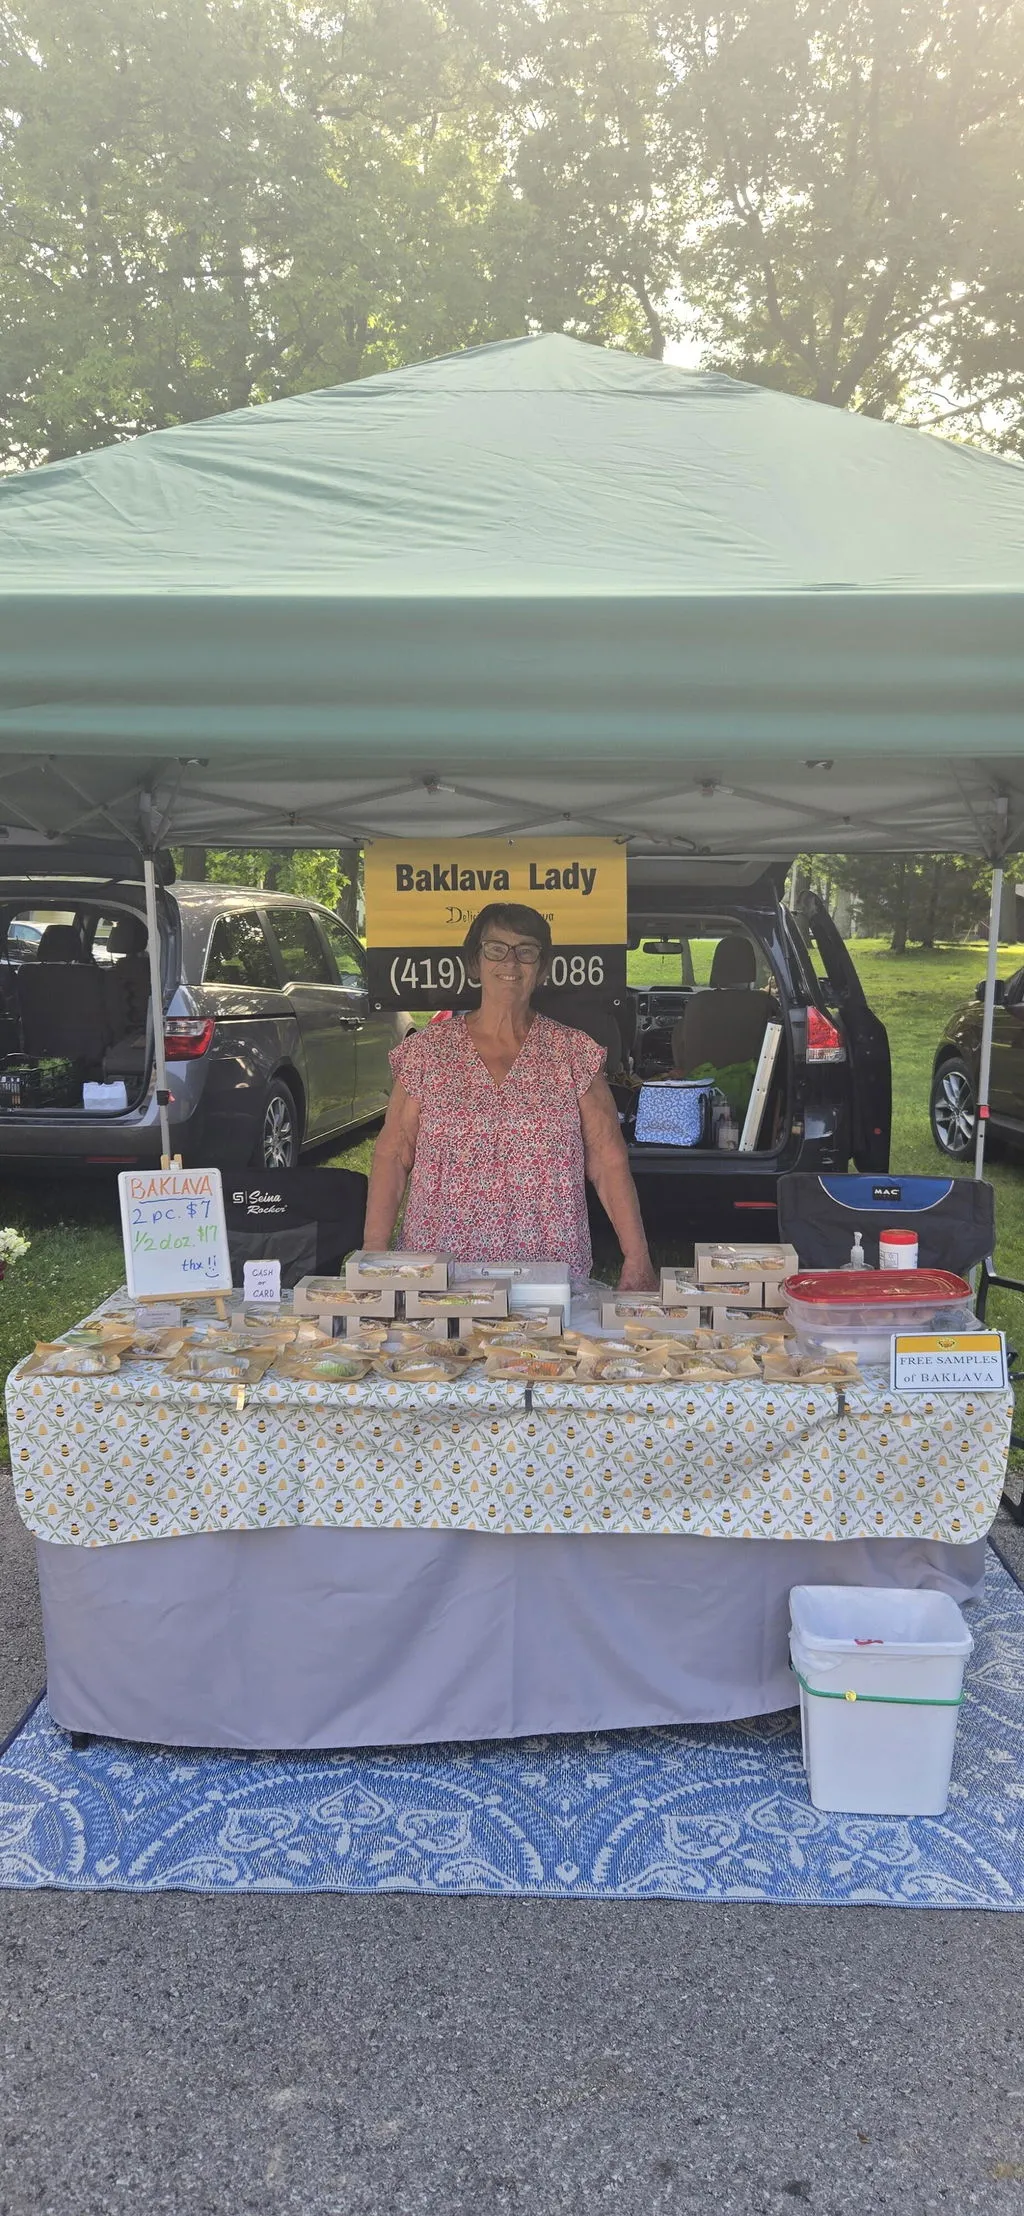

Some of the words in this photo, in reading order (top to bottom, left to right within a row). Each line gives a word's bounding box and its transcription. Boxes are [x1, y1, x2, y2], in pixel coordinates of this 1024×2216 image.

[396, 863, 510, 892] Baklava
[529, 862, 597, 895] Lady
[131, 1175, 213, 1199] BAKLAVA
[248, 1190, 282, 1204] Seina
[132, 1208, 147, 1225] 2
[152, 1209, 181, 1224] pc.
[186, 1200, 211, 1219] $7
[197, 1225, 218, 1243] $17
[182, 1259, 204, 1272] thx
[252, 1269, 274, 1277] CASH
[252, 1289, 275, 1298] CARD
[900, 1357, 933, 1365] FREE
[936, 1355, 998, 1364] SAMPLES
[904, 1374, 917, 1383] of
[921, 1372, 994, 1382] BAKLAVA
